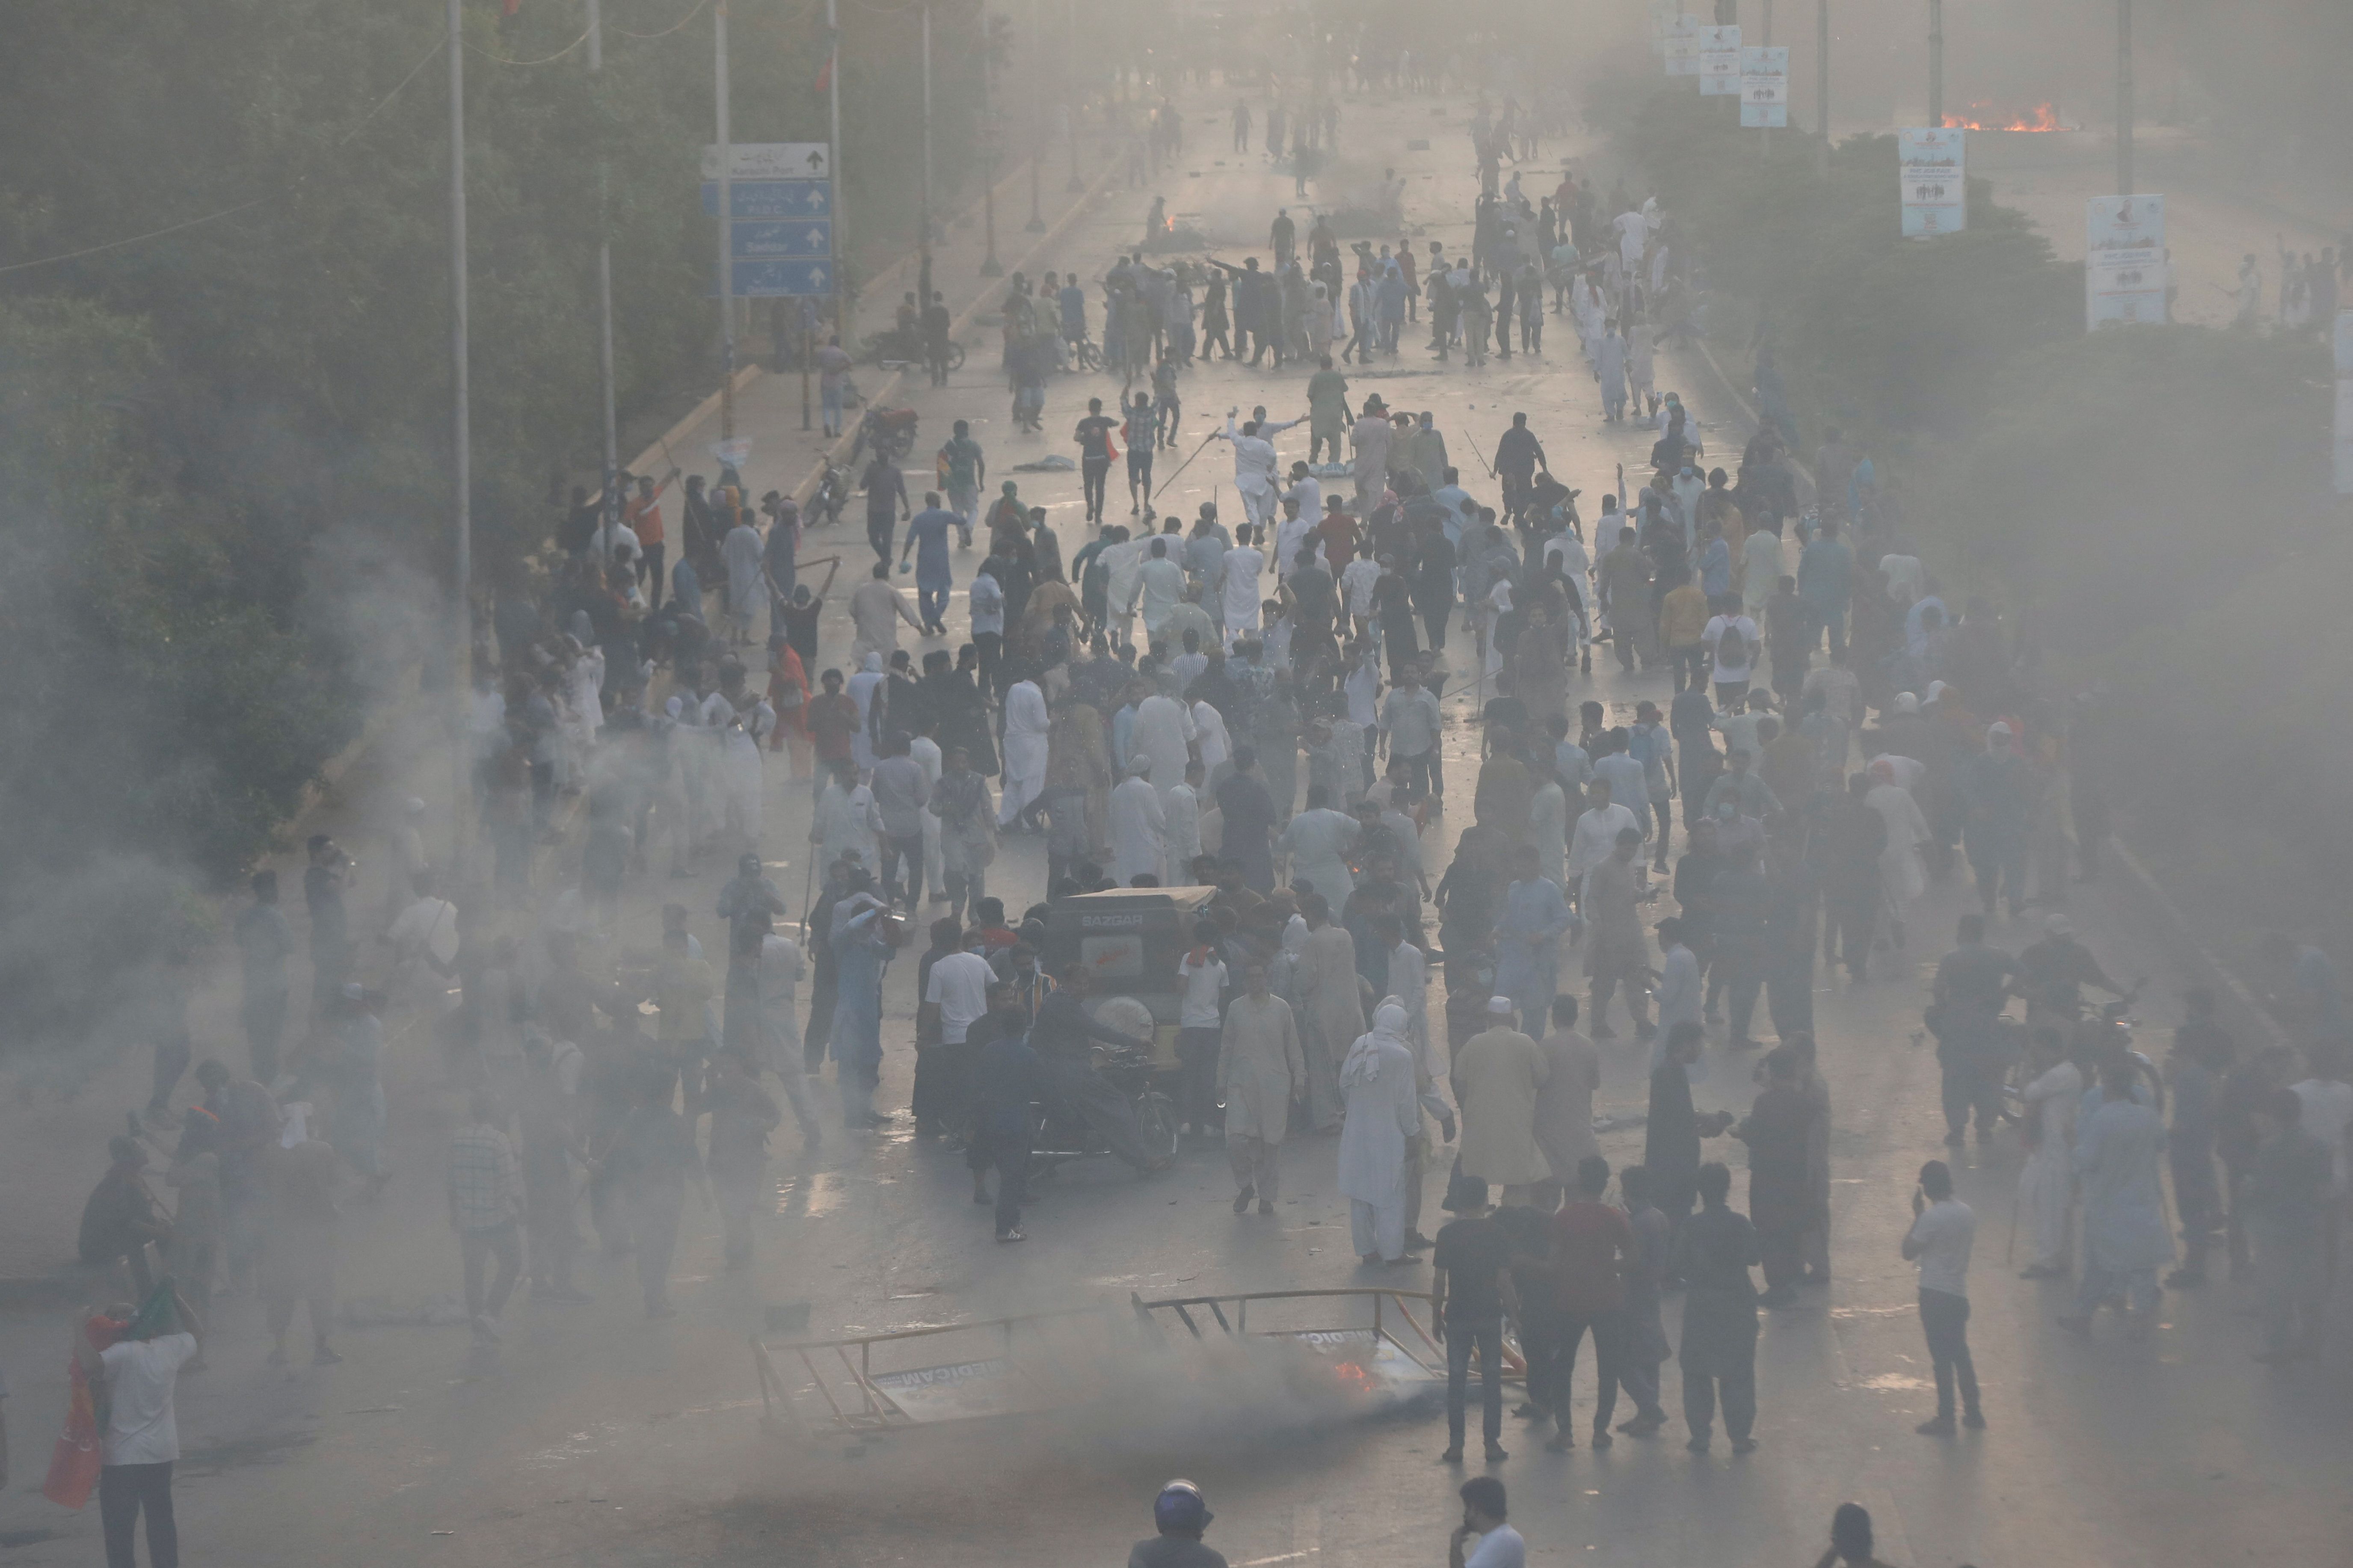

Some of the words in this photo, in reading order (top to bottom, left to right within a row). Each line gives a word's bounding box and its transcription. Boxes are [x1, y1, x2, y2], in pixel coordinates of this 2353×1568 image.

[1082, 915, 1143, 926] SAZGAR
[1295, 1331, 1375, 1344] MEDIC
[902, 1360, 1004, 1385] MEDICAM
